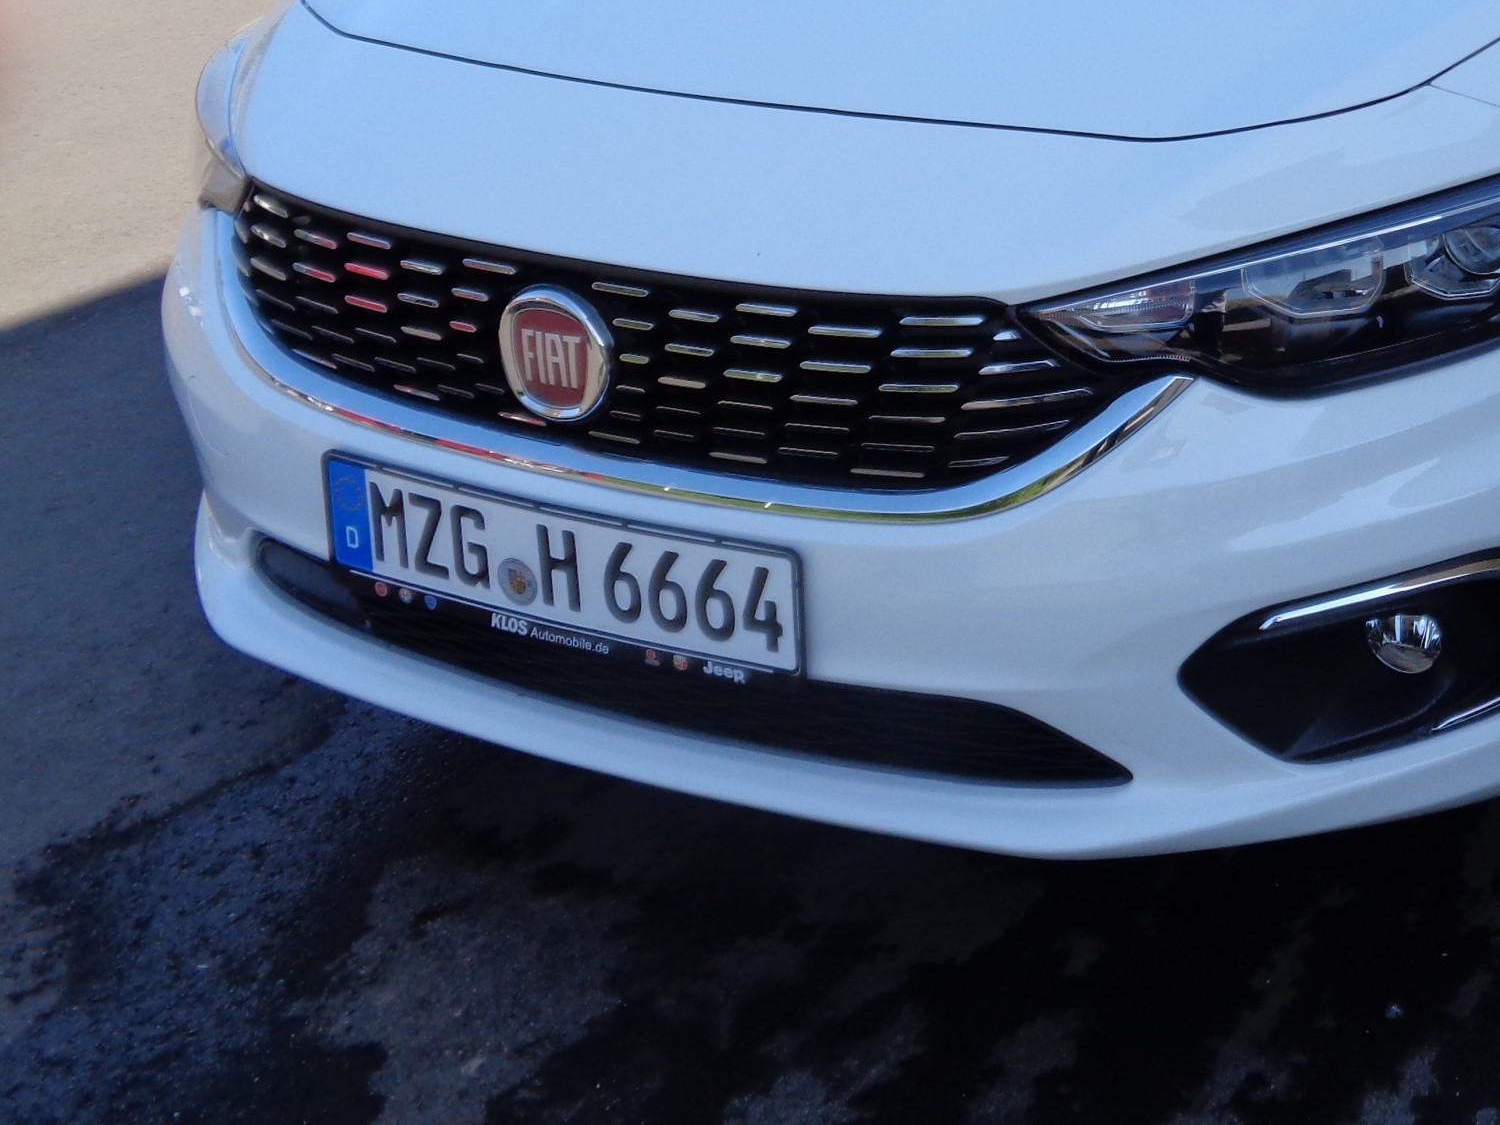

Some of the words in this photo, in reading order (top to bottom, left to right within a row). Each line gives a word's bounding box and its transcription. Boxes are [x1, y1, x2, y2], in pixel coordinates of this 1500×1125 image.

[521, 328, 580, 389] FIAT
[346, 526, 360, 549] D
[369, 481, 490, 589] MZG
[536, 523, 581, 612] H
[604, 542, 783, 653] 6664
[491, 613, 527, 636] KLOS
[530, 627, 609, 654] Automobile.de
[703, 661, 745, 684] Jeep
